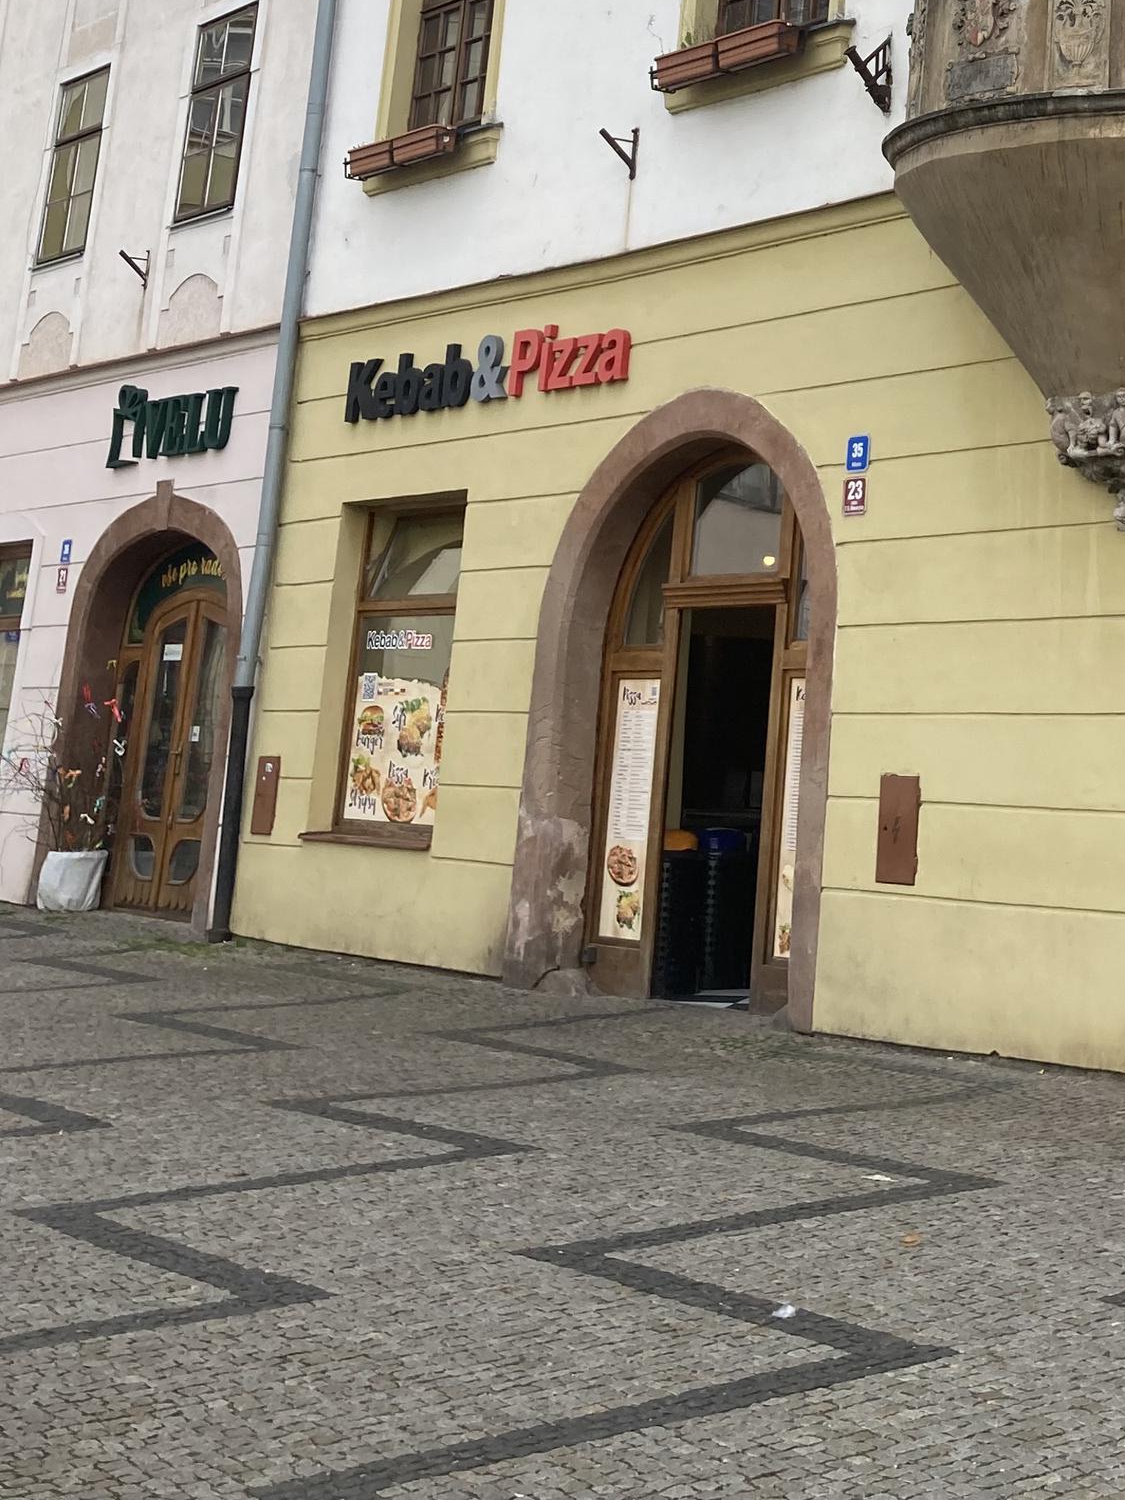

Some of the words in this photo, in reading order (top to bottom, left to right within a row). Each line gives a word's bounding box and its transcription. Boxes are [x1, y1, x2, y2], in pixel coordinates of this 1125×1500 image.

[344, 324, 632, 423] Kebab&Pizza
[851, 443, 863, 458] 35
[847, 480, 863, 500] 23
[178, 558, 198, 586] pro
[366, 630, 433, 649] Kebab&Pizza
[388, 760, 409, 785] Pizza
